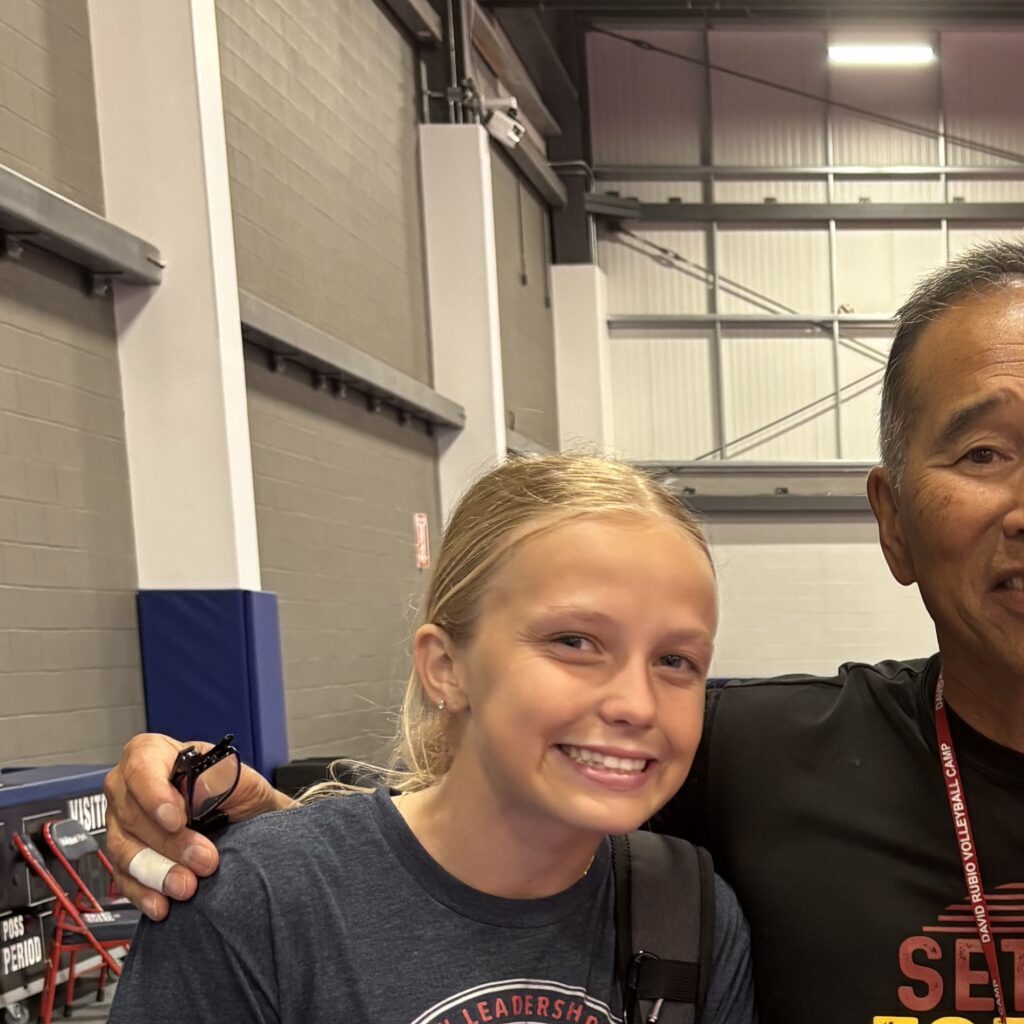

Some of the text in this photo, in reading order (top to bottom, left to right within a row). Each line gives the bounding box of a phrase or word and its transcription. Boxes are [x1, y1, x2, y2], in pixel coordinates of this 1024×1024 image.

[940, 743, 991, 943] DAVID RUBIO VOLLEYBALL CAMP
[2, 914, 25, 941] POSS
[2, 936, 42, 976] PERIOD
